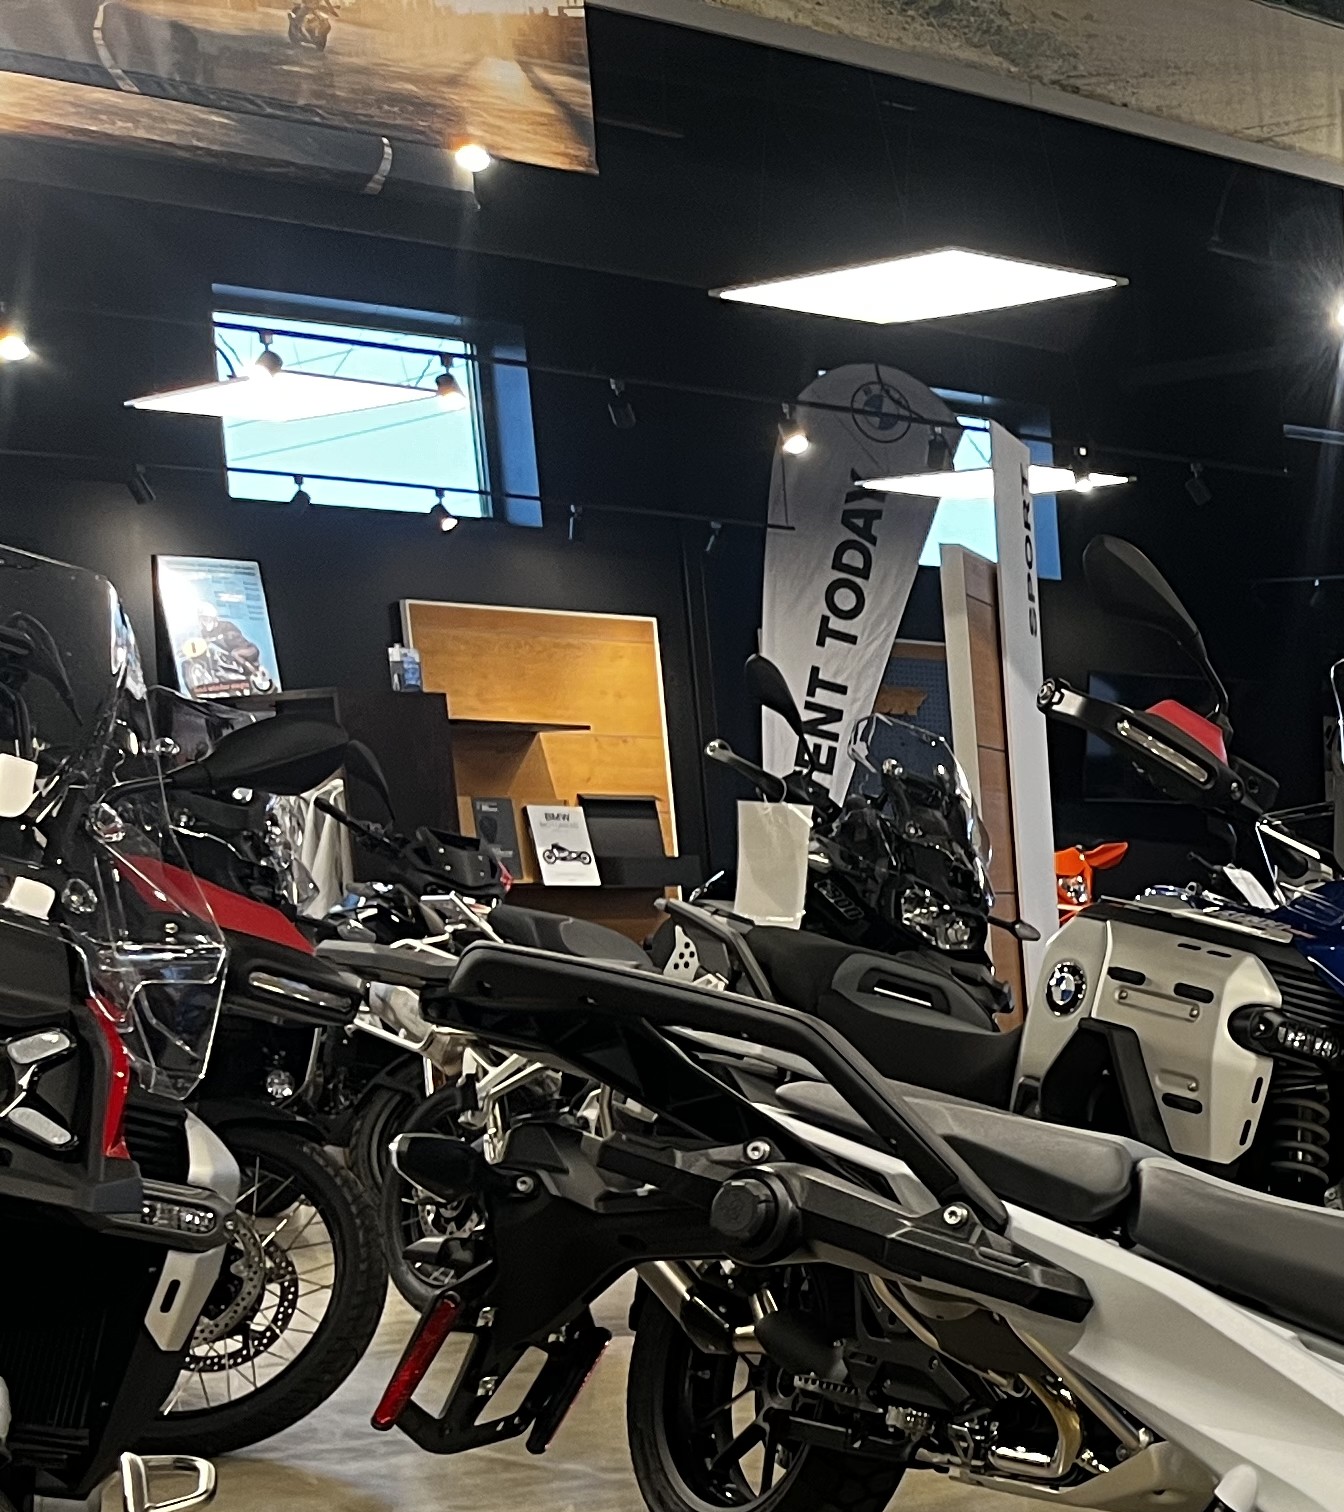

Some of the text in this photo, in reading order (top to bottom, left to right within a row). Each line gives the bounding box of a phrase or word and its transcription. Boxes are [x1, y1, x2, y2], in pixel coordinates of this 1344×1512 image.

[816, 467, 887, 647] TODAY
[1020, 462, 1038, 638] SPORT
[794, 665, 848, 777] ENT
